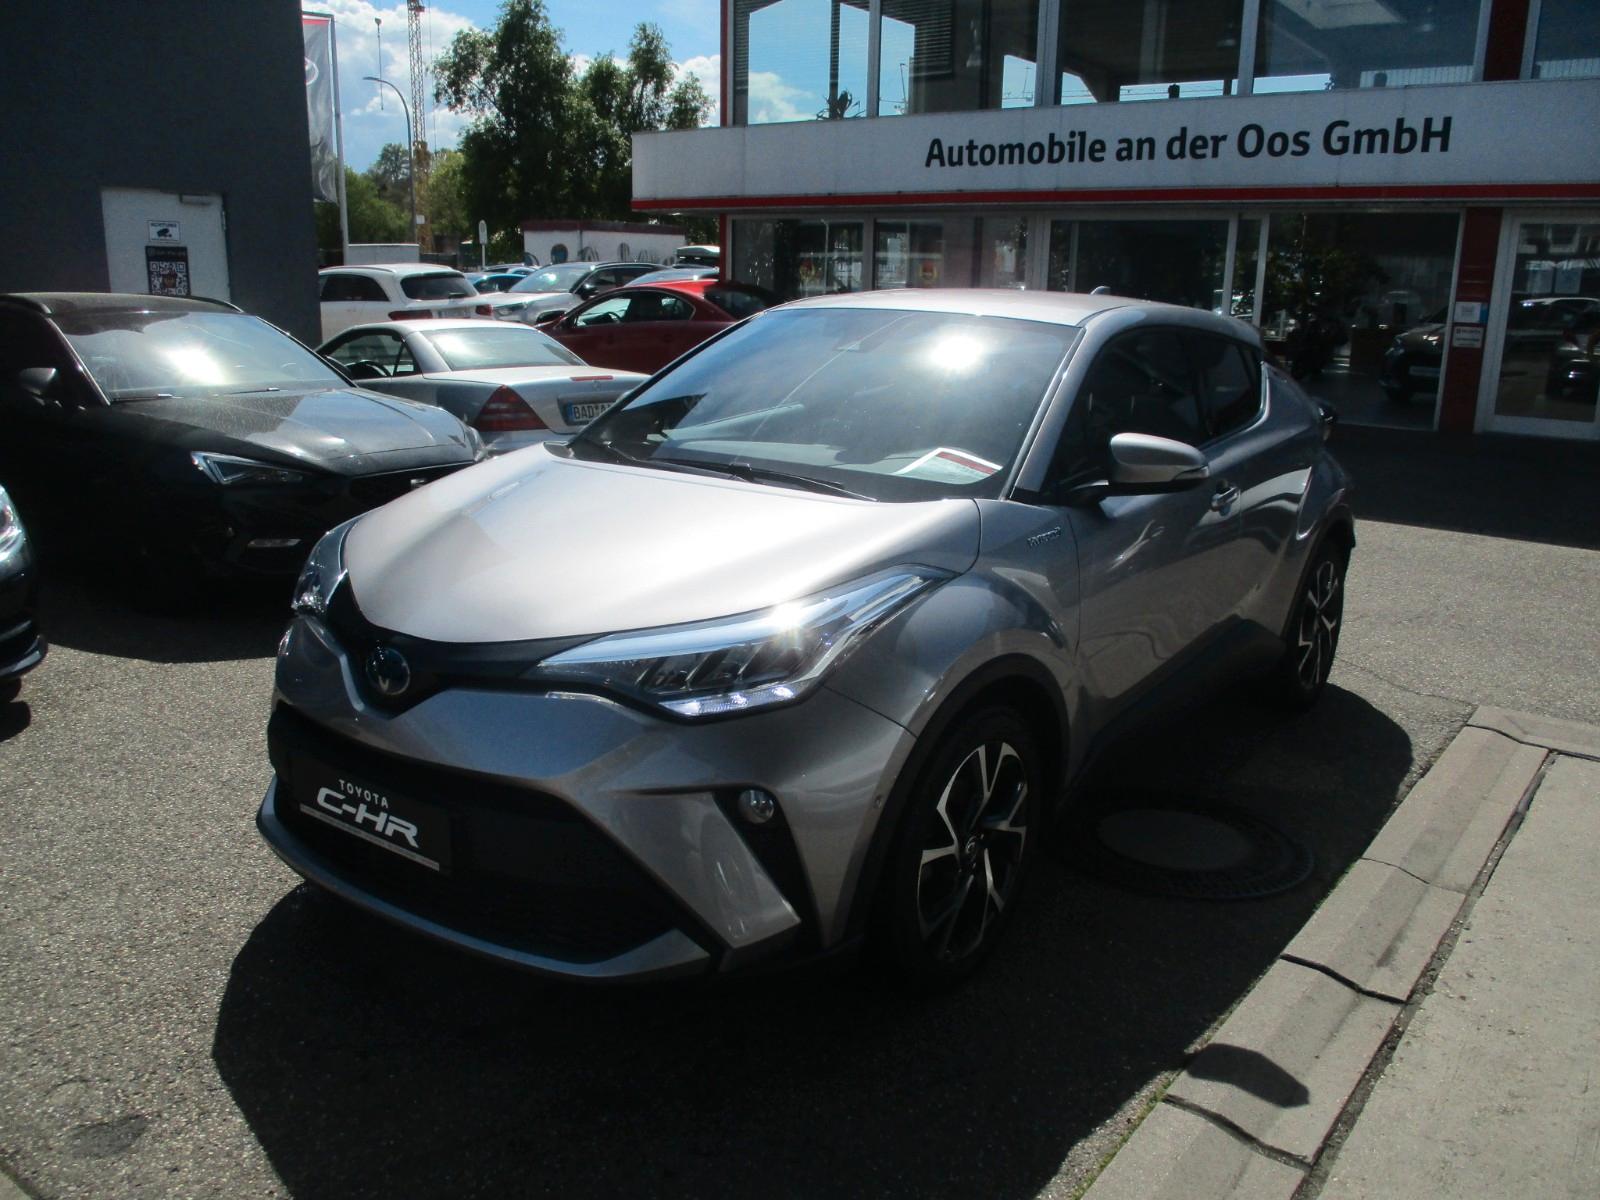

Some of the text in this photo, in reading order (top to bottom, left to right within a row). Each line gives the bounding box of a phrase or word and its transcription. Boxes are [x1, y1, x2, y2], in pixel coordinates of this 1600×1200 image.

[925, 116, 1453, 168] Automobile an der Oos GmbH
[316, 787, 420, 849] C-HR
[338, 779, 389, 809] TOYOTA
